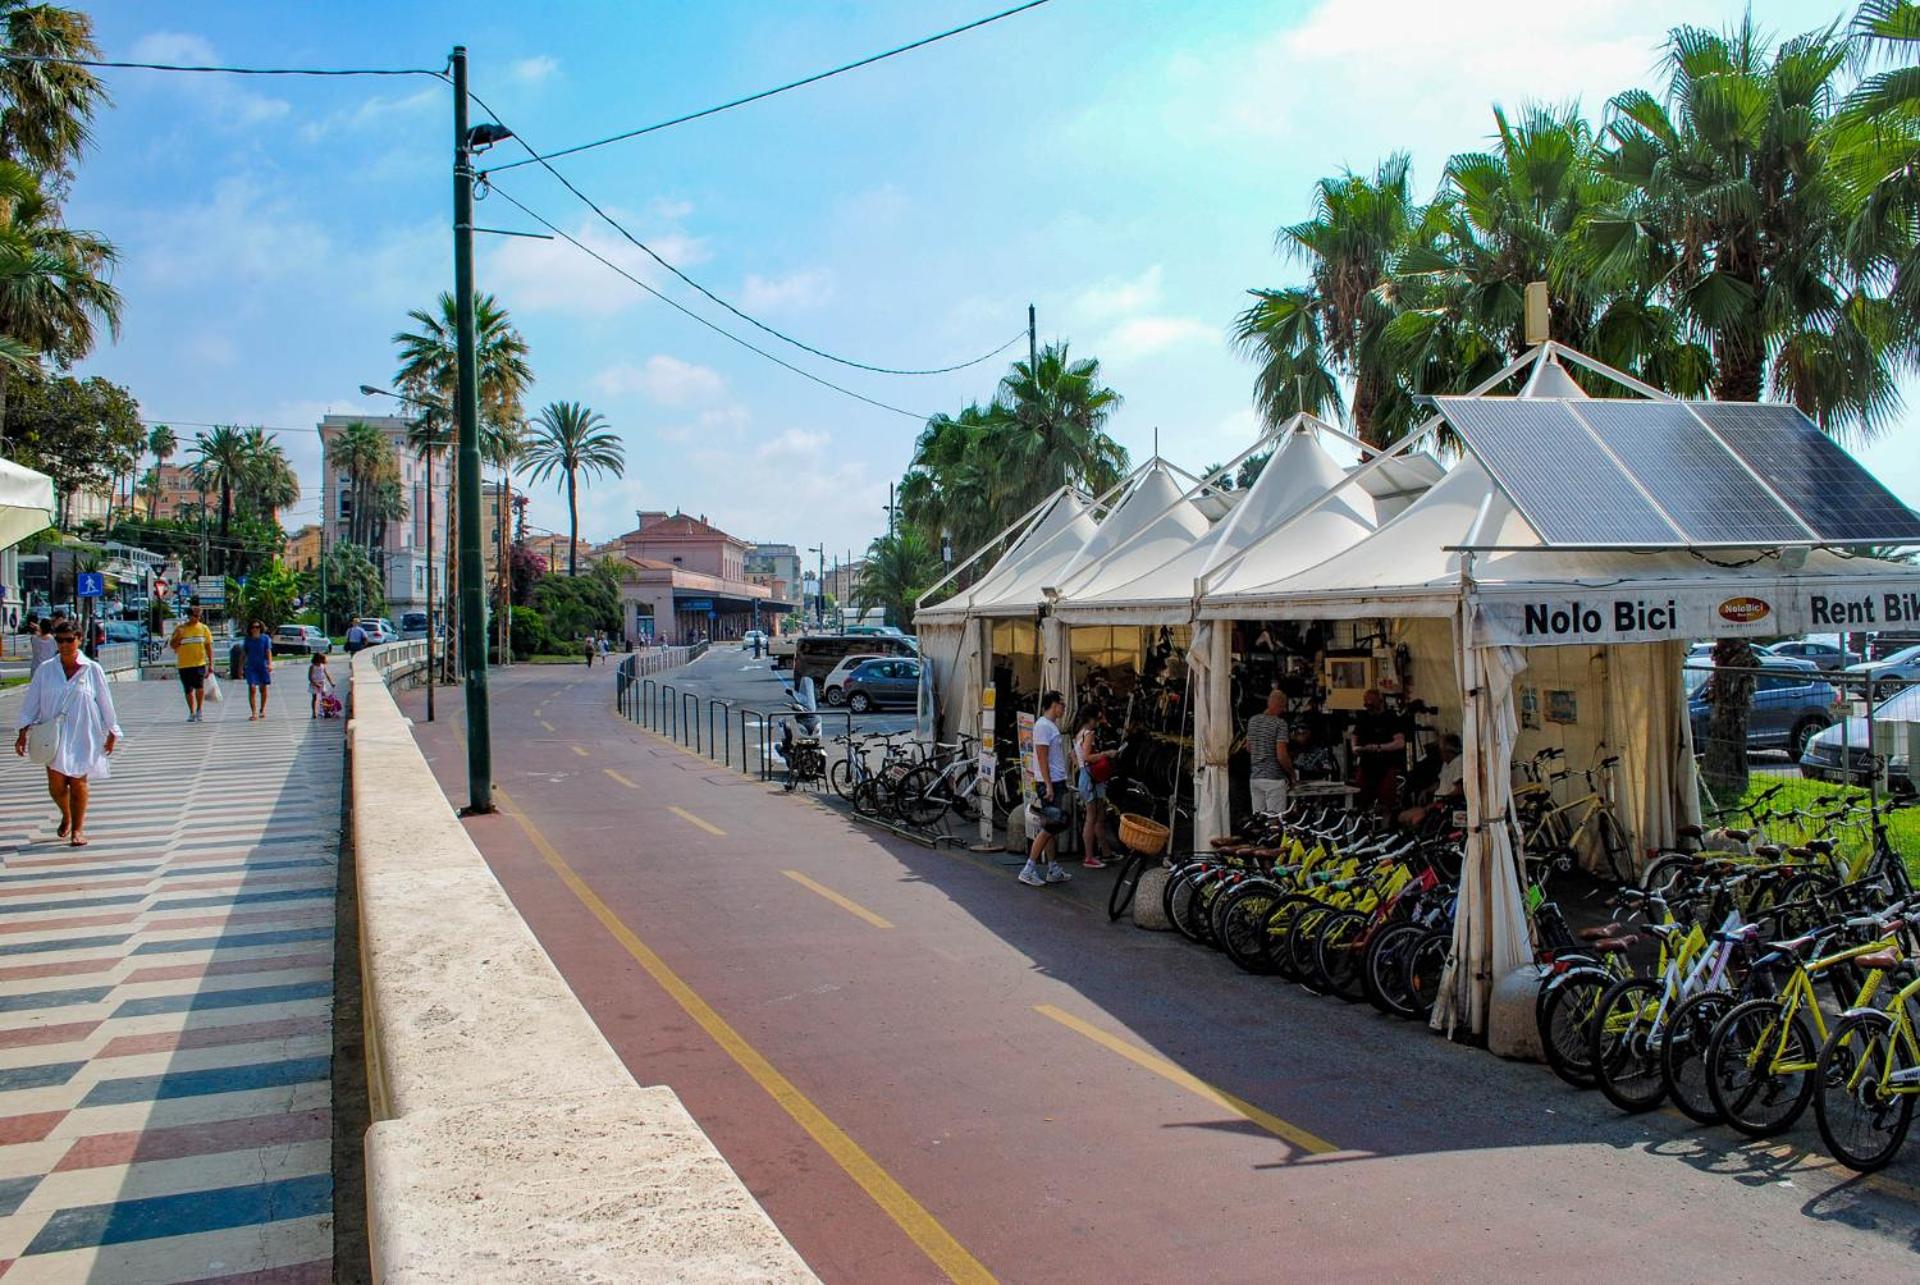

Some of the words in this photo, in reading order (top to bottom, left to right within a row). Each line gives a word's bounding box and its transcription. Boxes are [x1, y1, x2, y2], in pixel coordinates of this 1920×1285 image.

[1525, 602, 1602, 635] Nolo
[1614, 600, 1676, 632] Bici
[1725, 602, 1764, 613] NoloBici
[1811, 594, 1876, 625] Rent
